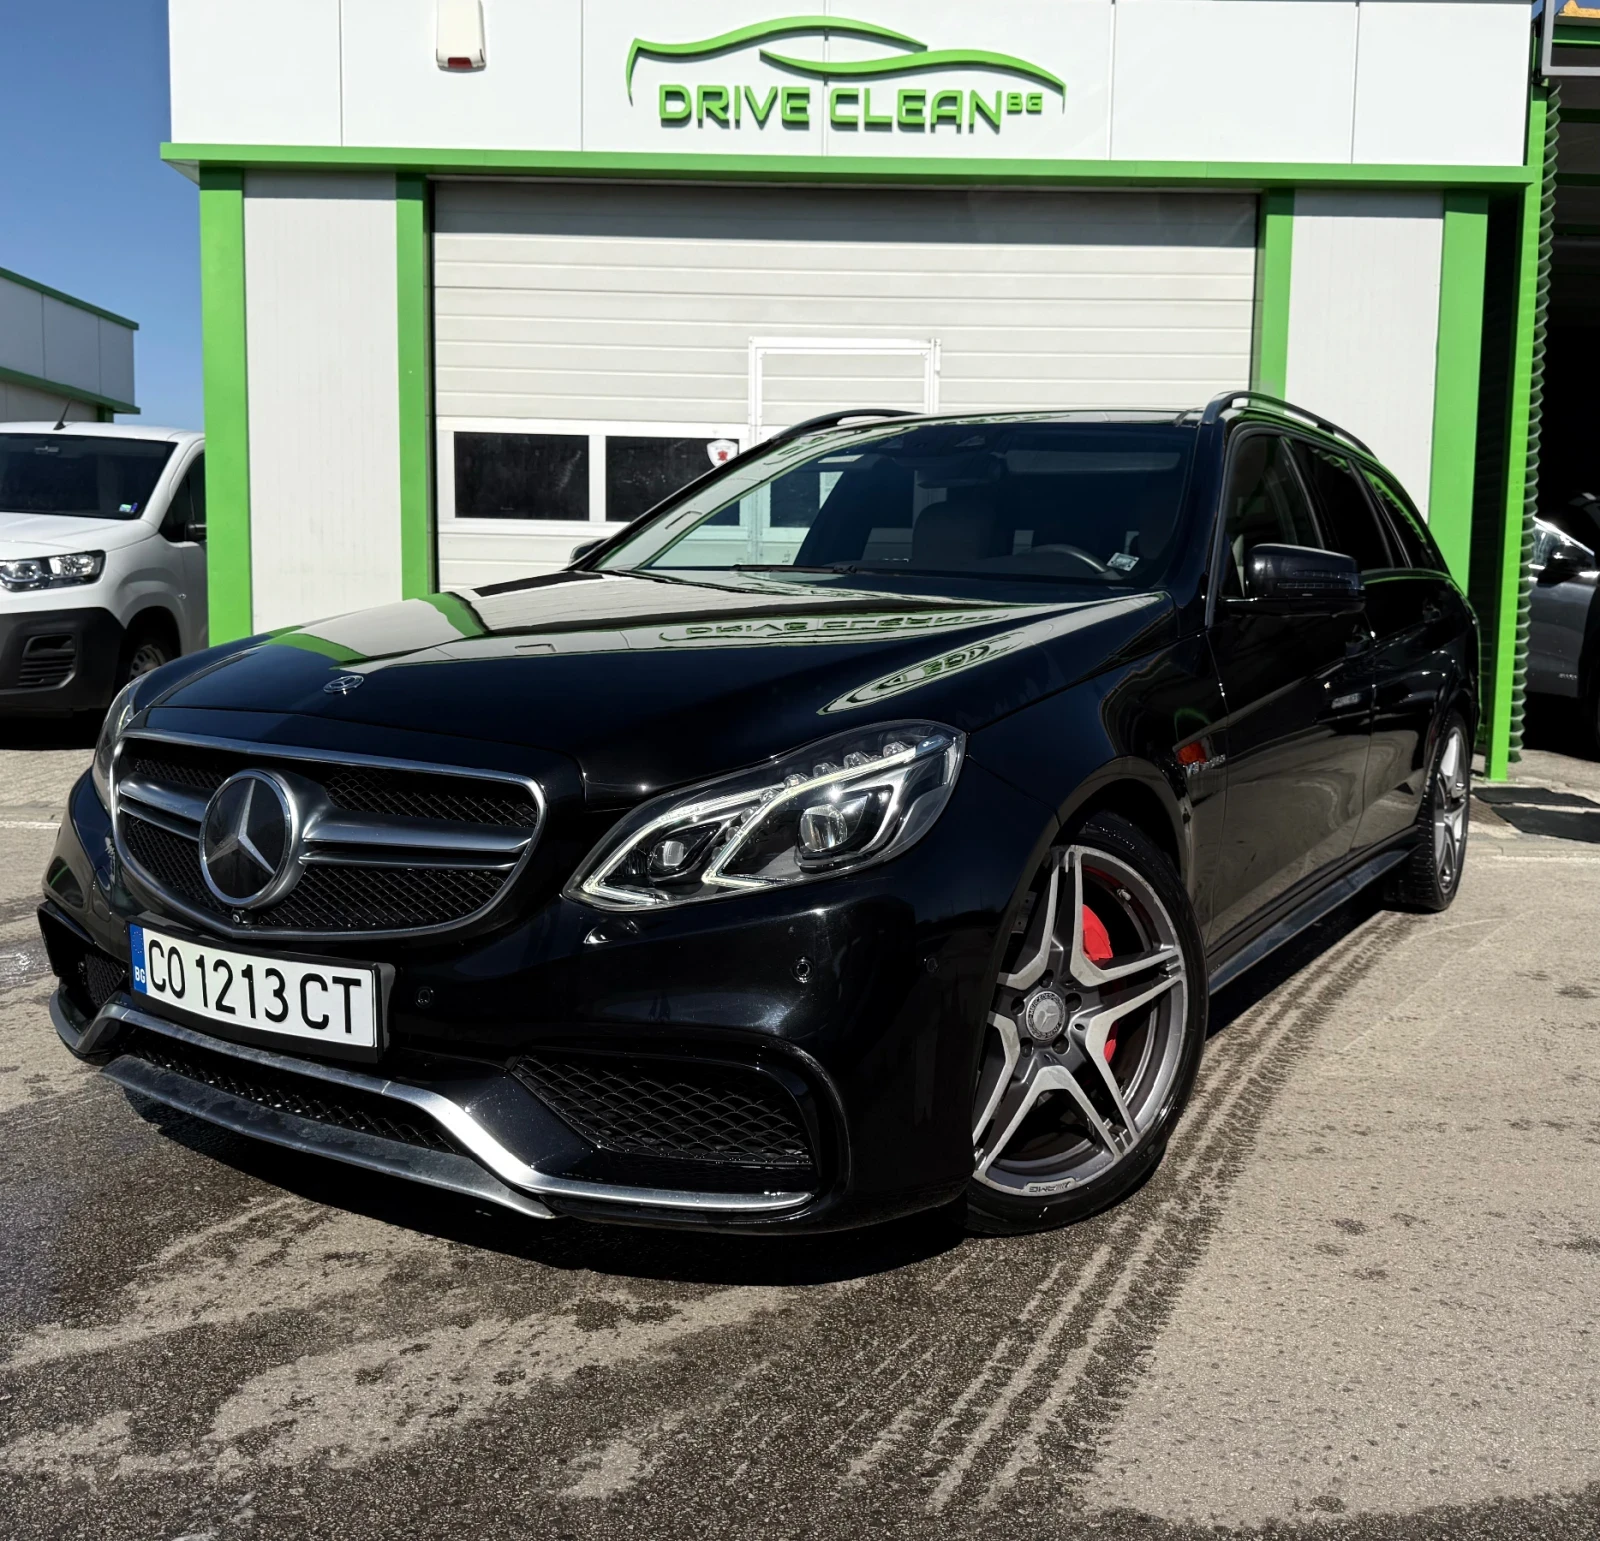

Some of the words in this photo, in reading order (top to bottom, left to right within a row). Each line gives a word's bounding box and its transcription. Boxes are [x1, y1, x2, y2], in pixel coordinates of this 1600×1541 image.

[659, 84, 811, 123] DRIVE
[830, 87, 1003, 126] CLEAN
[1006, 92, 1043, 112] BG
[134, 965, 146, 984] BG
[148, 939, 186, 999] CO
[195, 953, 289, 1023] 1213
[300, 972, 362, 1034] CT
